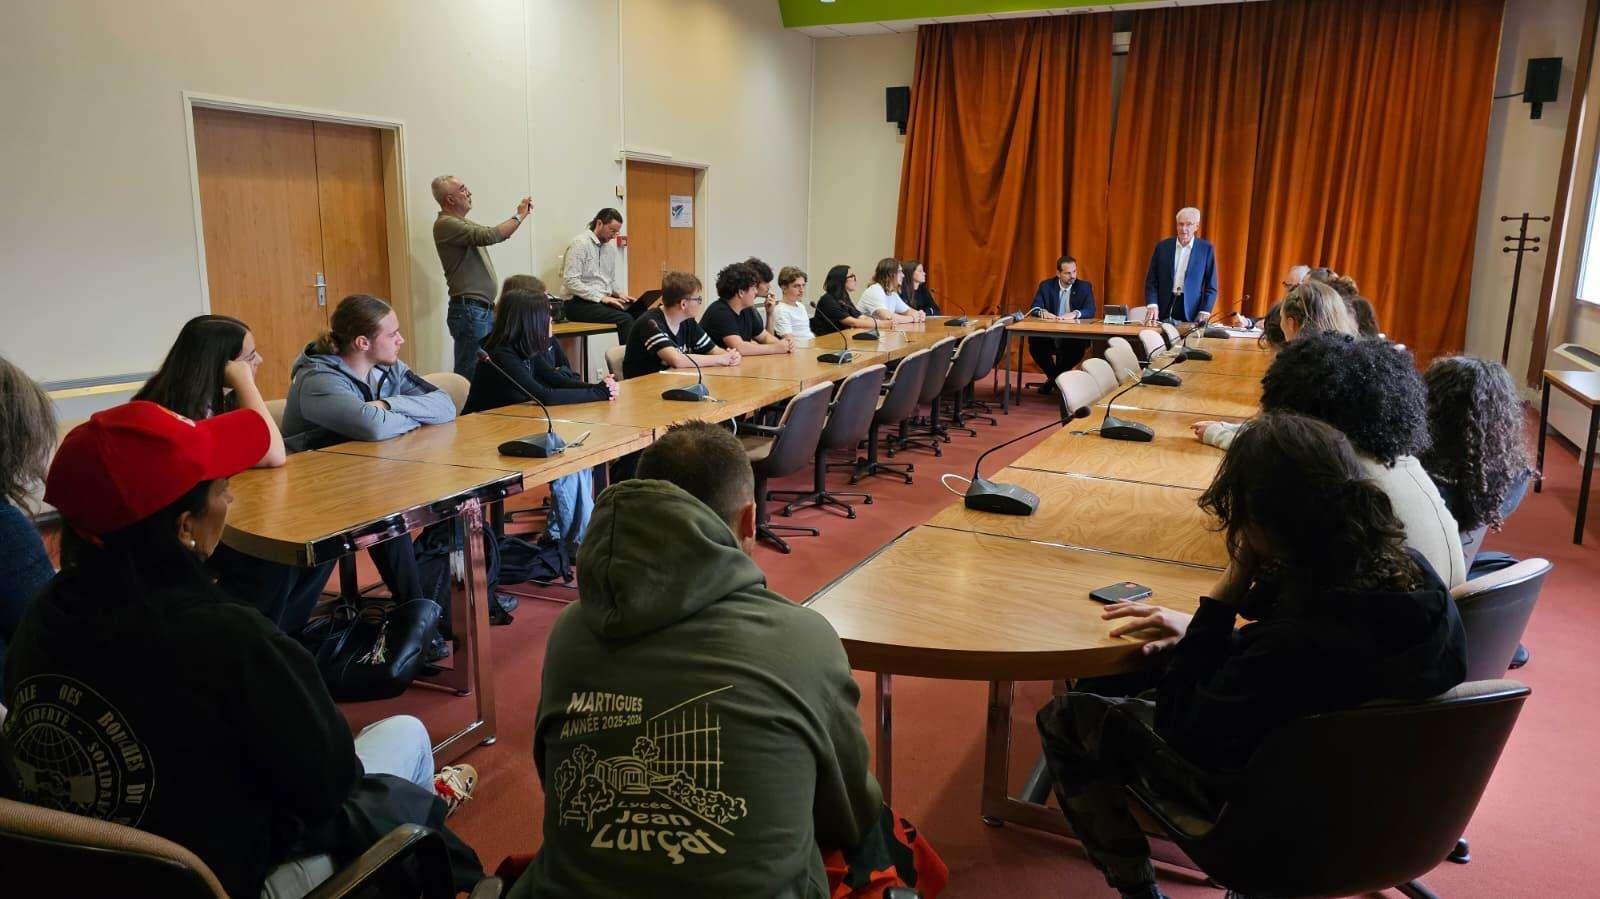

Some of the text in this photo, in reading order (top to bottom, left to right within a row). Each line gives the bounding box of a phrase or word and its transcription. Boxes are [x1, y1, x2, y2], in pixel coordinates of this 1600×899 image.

[566, 692, 643, 713] MARTIGUES
[560, 714, 642, 739] ANNÉE 2025-2026
[16, 684, 146, 804] ALE DES BOUCHES DU
[87, 742, 113, 815] SOLIDAR
[615, 810, 691, 826] Jean
[591, 824, 727, 864] Lurçat
